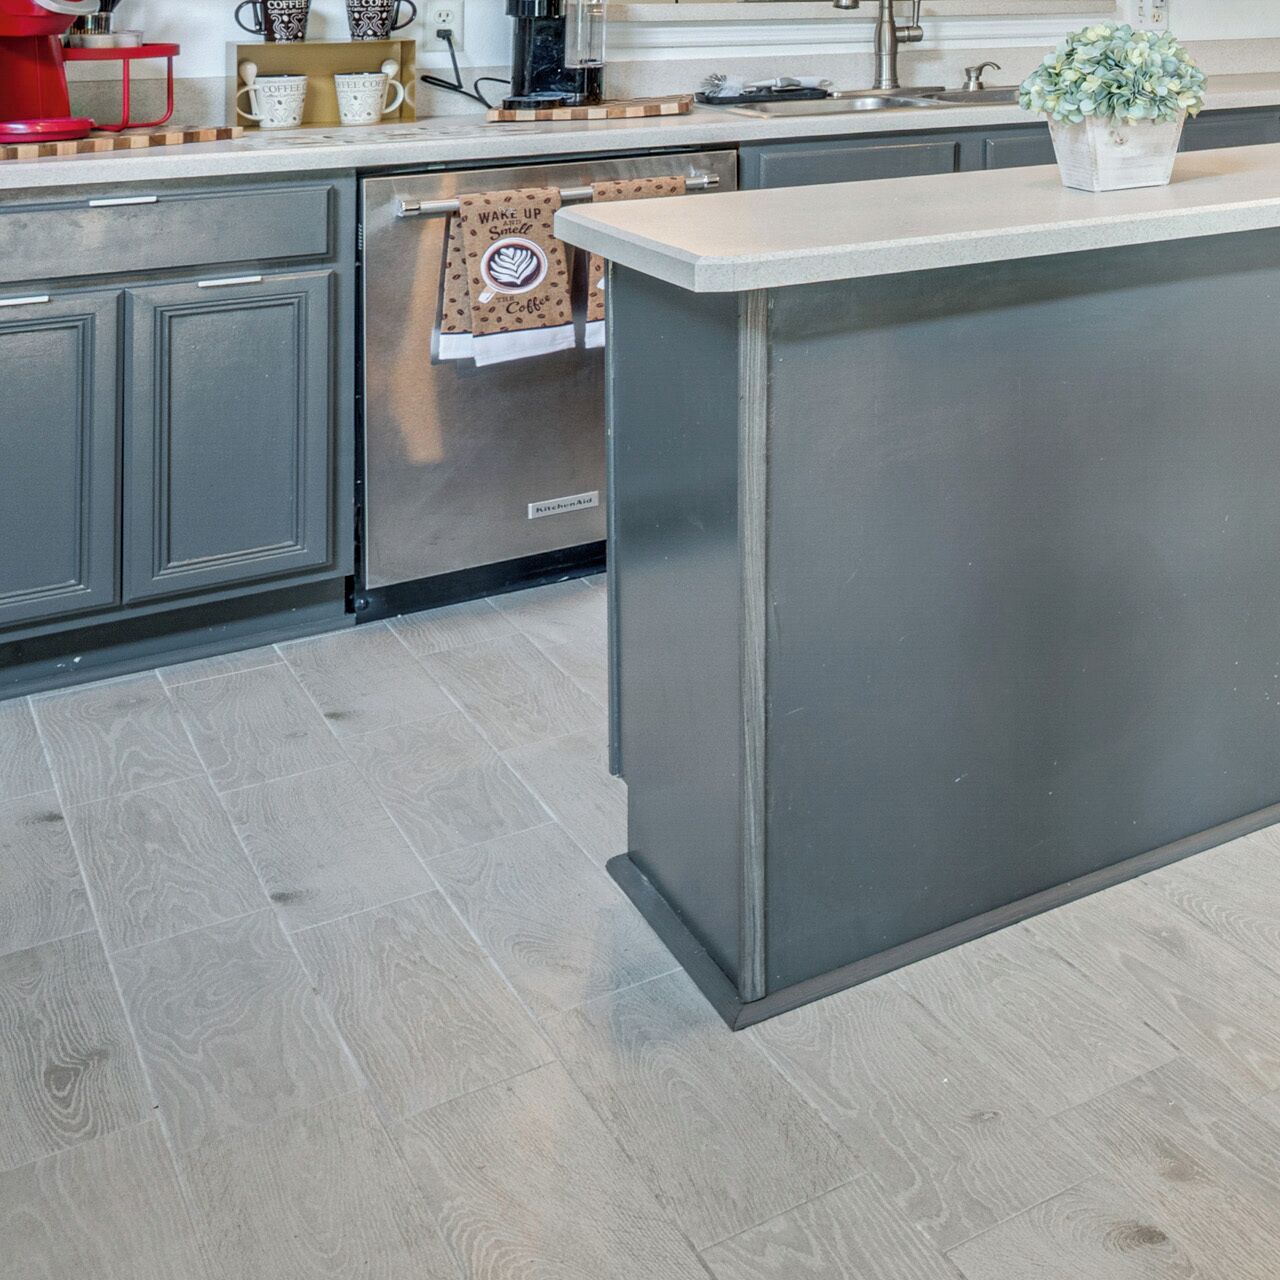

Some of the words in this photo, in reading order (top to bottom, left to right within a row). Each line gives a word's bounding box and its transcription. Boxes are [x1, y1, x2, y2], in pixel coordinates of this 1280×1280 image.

[267, 0, 307, 9] COFFEE
[479, 209, 517, 224] WAKE
[524, 208, 541, 219] UP
[489, 223, 533, 240] Smell
[506, 295, 550, 314] Coffee
[536, 498, 592, 513] KitchenAid
